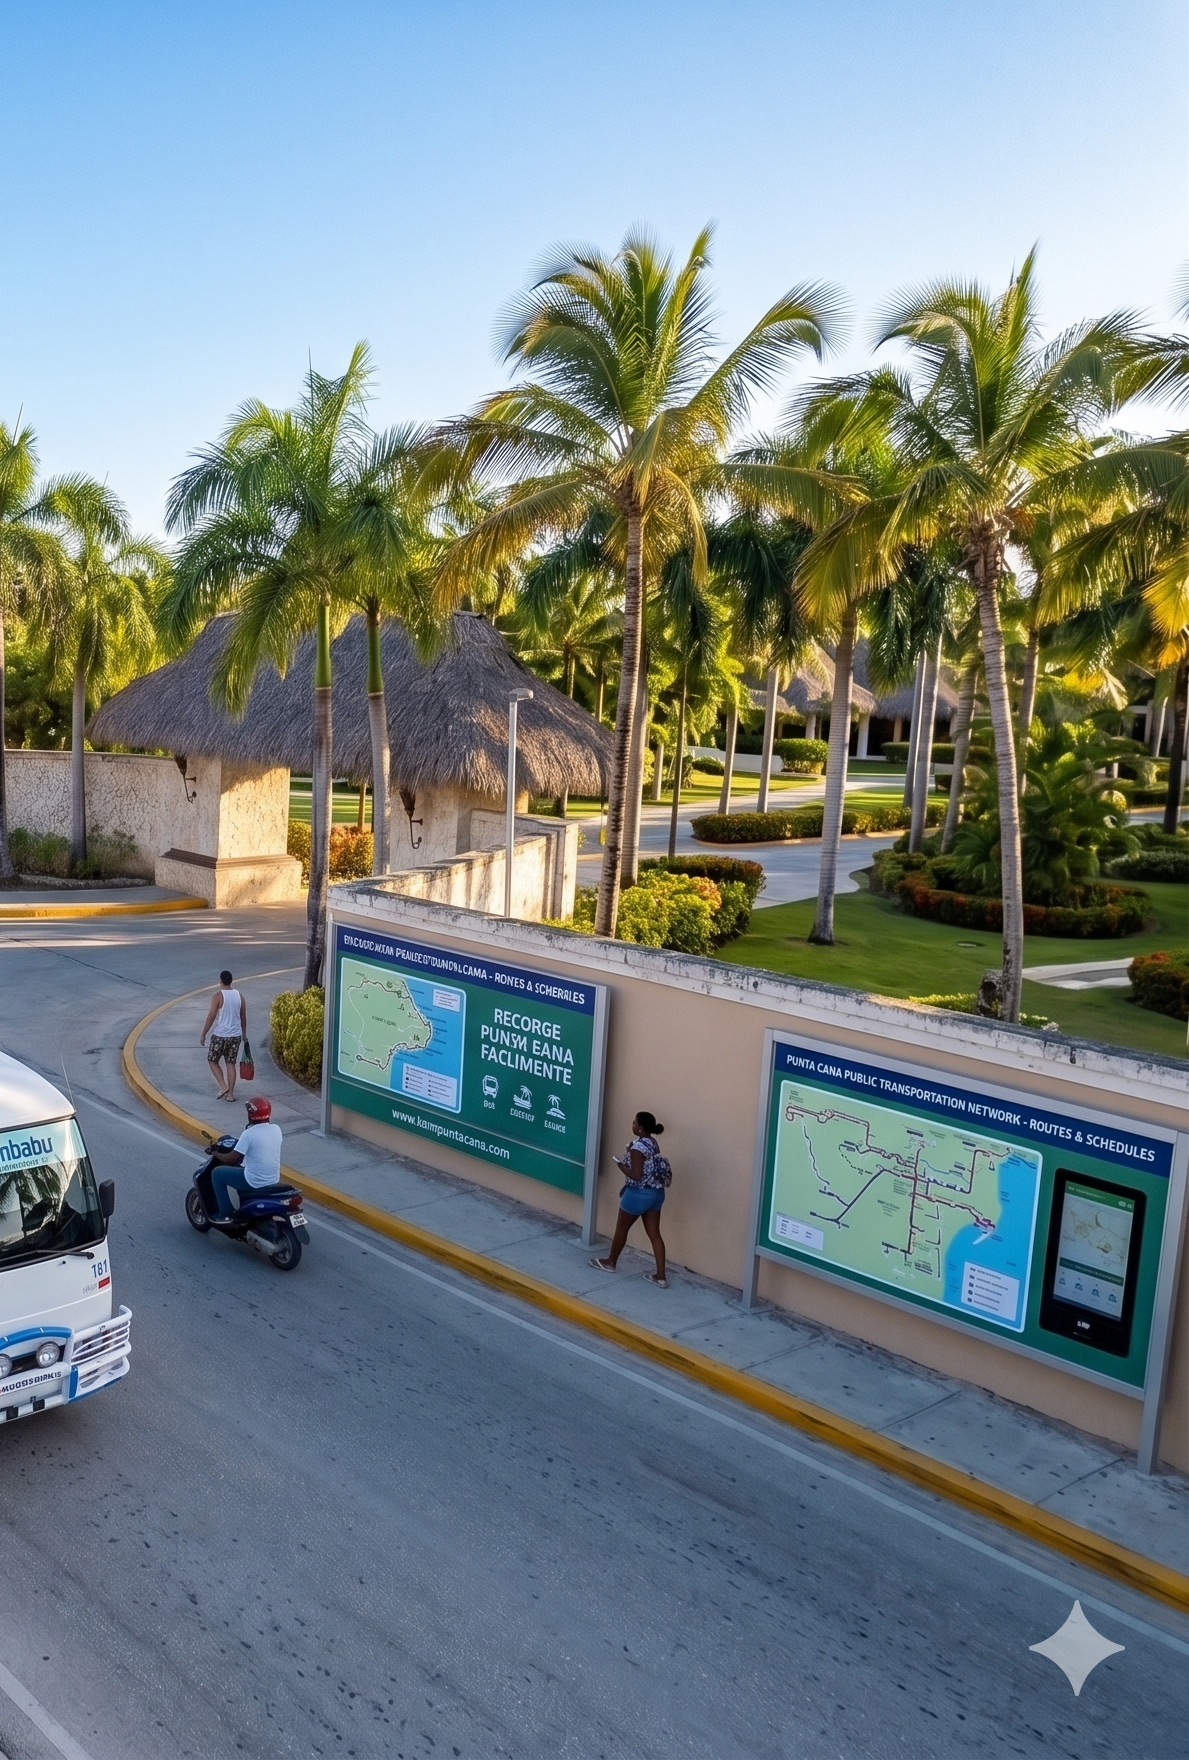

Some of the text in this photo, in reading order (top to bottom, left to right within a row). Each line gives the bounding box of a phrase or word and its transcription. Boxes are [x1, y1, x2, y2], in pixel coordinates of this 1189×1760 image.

[494, 1007, 561, 1041] RECORGE
[481, 1043, 572, 1086] FACLIMENTE
[532, 1039, 575, 1066] EANA
[786, 1054, 815, 1071] PUNTA
[817, 1062, 843, 1079] CANA
[844, 1069, 878, 1088] PUBLIC
[879, 1078, 966, 1111] TRANSPORTATION
[967, 1101, 1021, 1126] NETWORK
[1029, 1118, 1072, 1140] ROUTES
[1074, 1131, 1083, 1143] &
[1085, 1134, 1156, 1162] SCHEDULES
[91, 1259, 108, 1279] 181
